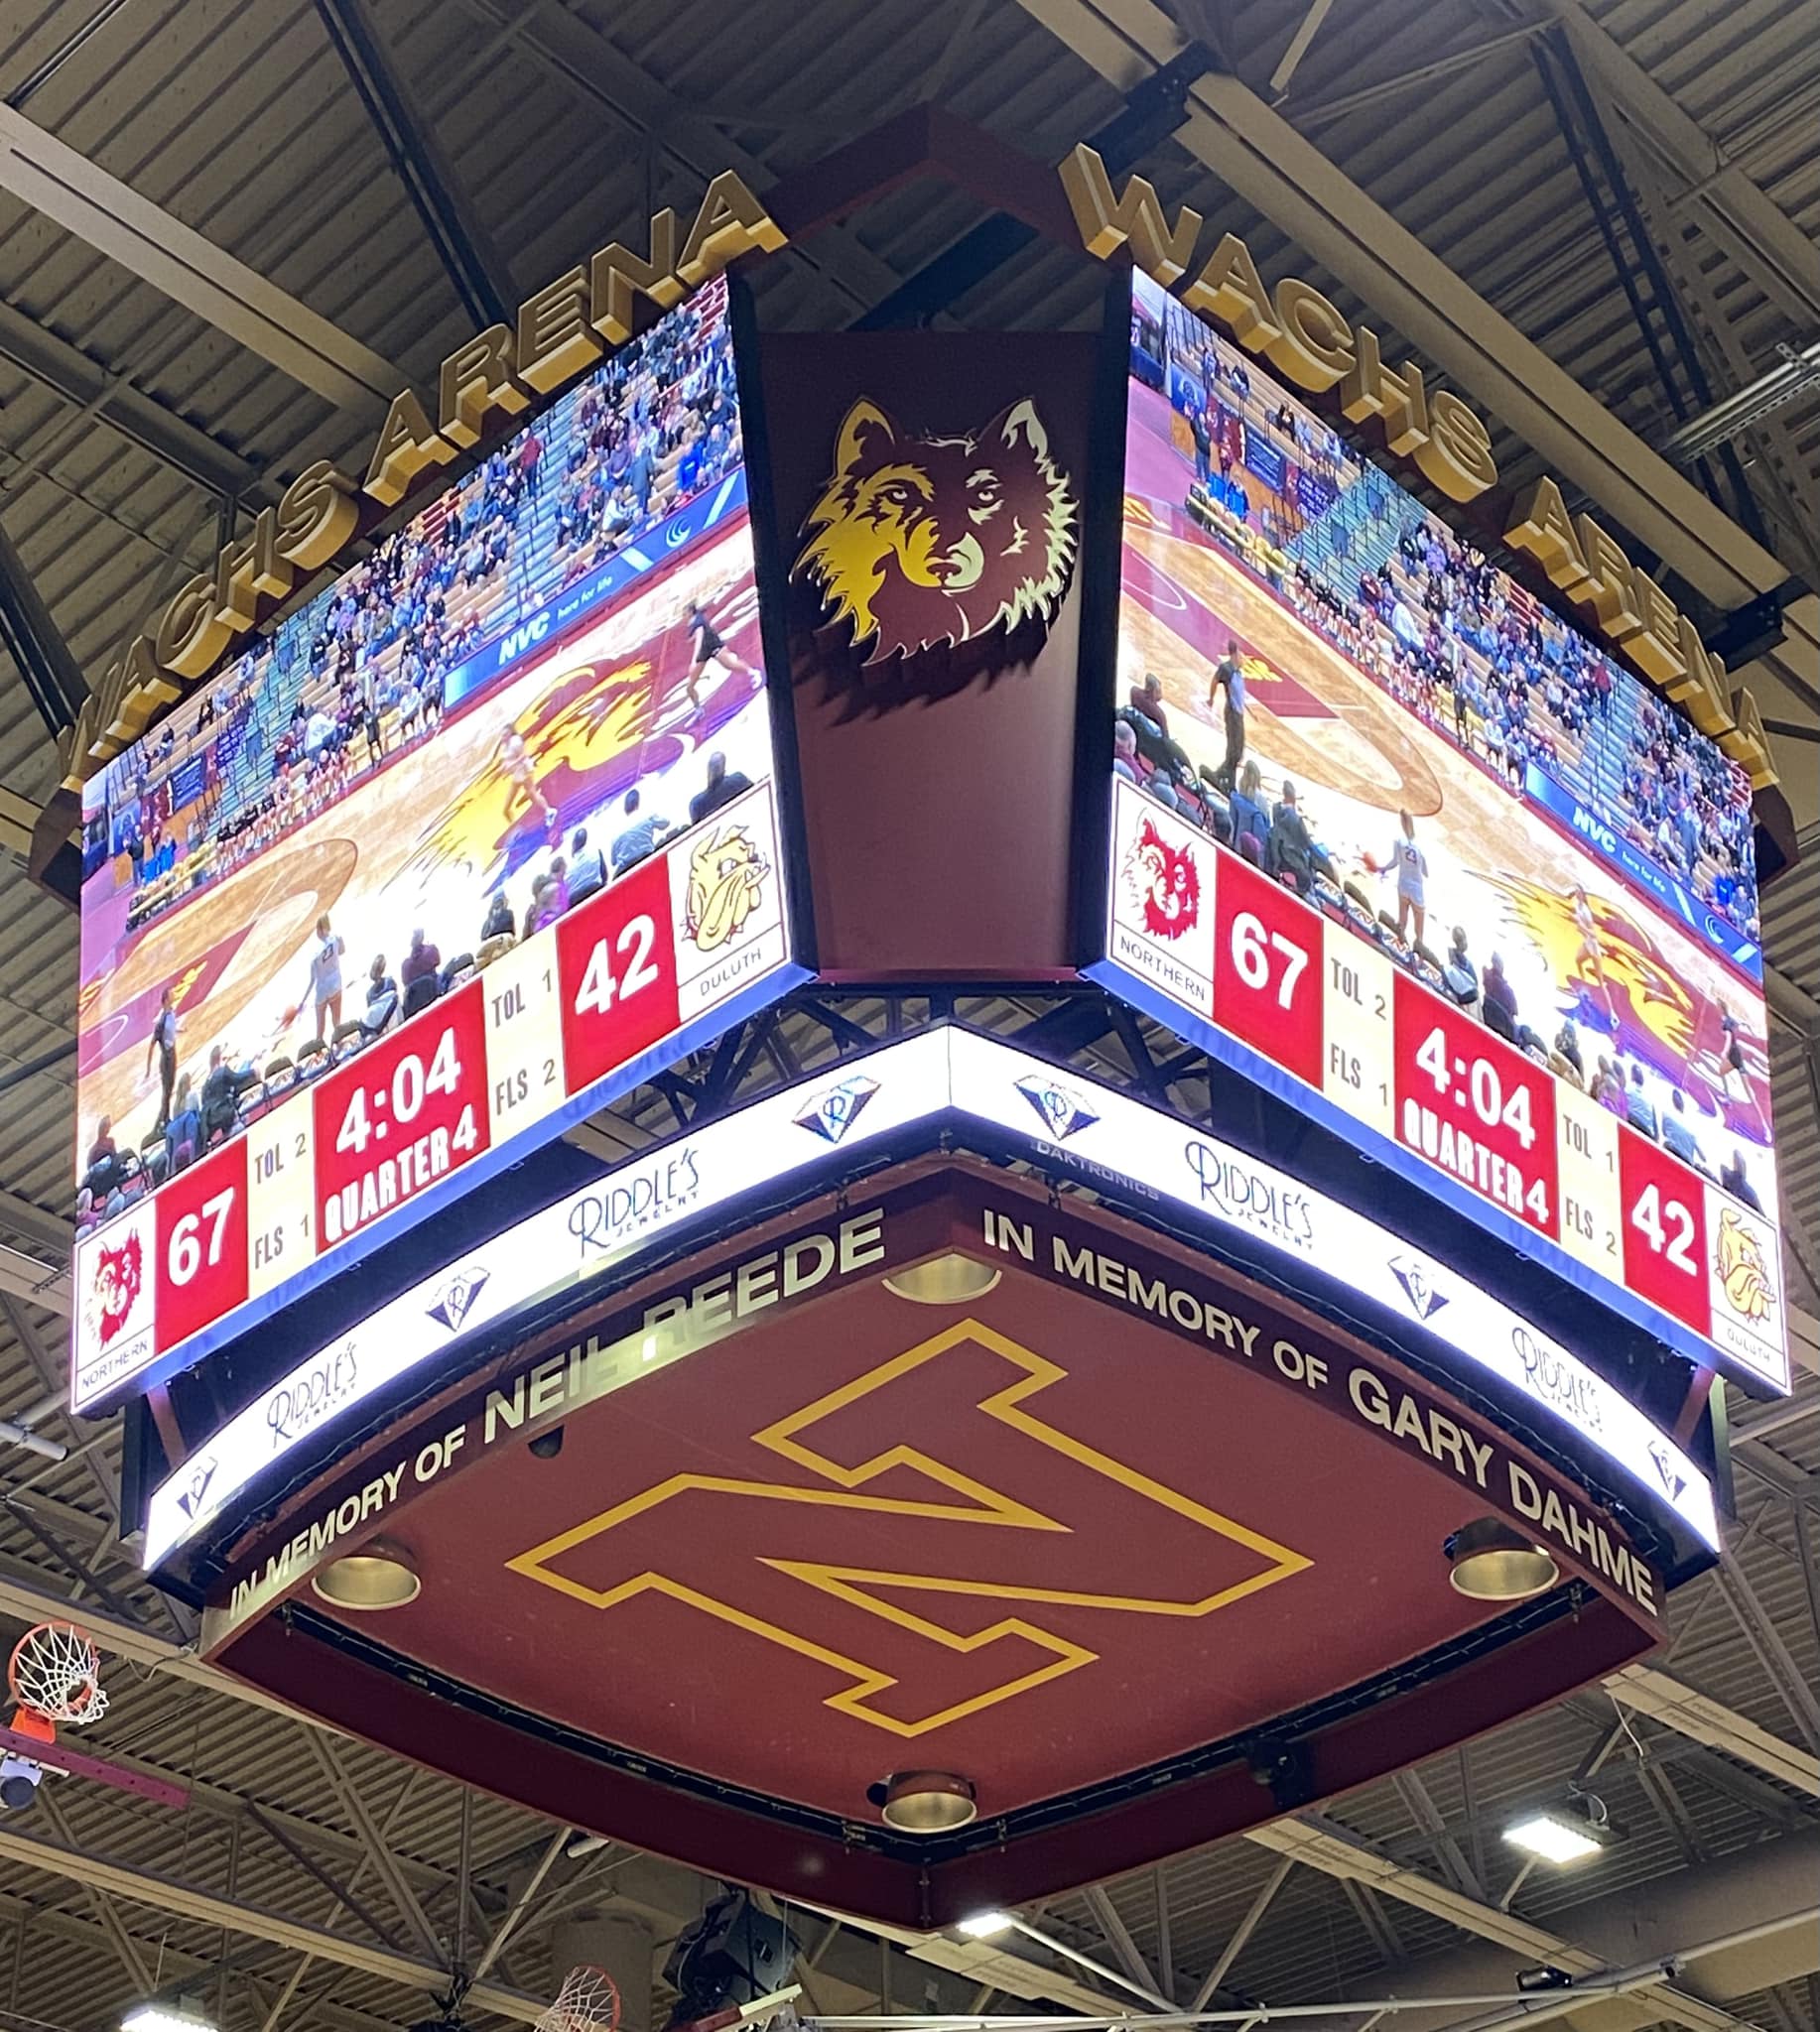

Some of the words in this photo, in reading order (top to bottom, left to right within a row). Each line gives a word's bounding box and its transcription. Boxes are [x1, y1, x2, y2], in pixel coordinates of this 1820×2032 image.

[57, 459, 359, 794] WACHS
[362, 169, 788, 507] ARENA
[1058, 142, 1497, 503] WACHS
[1501, 475, 1779, 791] ARENA
[498, 611, 551, 666] NVC
[1573, 806, 1617, 853] NVC
[491, 982, 526, 1029] TOL
[542, 968, 552, 993] 1
[575, 914, 659, 1016] 42
[700, 947, 762, 996] DULUTH
[1119, 936, 1206, 1002] NORTHERN
[1232, 911, 1308, 1010] 67
[1331, 956, 1363, 1007] TOL
[1374, 994, 1386, 1021] 2
[336, 1027, 461, 1154] 4:04
[495, 1072, 529, 1115] FLS
[544, 1059, 556, 1086] 2
[1331, 1044, 1362, 1090] FLS
[1379, 1082, 1387, 1106] 1
[1416, 1027, 1536, 1150] 4:04
[255, 1143, 285, 1185] TOL
[295, 1133, 307, 1159] 2
[325, 1126, 450, 1243] QUARTER
[453, 1103, 477, 1151] 4
[1036, 1140, 1160, 1202] DAKTRONICS
[1403, 1097, 1524, 1214] QUARTER
[1526, 1178, 1549, 1225] 4
[1563, 1114, 1592, 1160] TOL
[1606, 1150, 1614, 1173] 1
[569, 1148, 700, 1258] RIDDLE'S
[1185, 1141, 1312, 1238] RIDDLE'S
[1565, 1197, 1594, 1240] FLS
[1606, 1230, 1617, 1257] 2
[167, 1186, 235, 1287] 67
[255, 1225, 284, 1270] FLS
[301, 1214, 309, 1237] 1
[1631, 1183, 1698, 1277] 42
[81, 1338, 149, 1389] NORTHERN
[229, 1570, 259, 1620] IN
[265, 1461, 407, 1586] MEMORY
[414, 1425, 466, 1483] OF
[483, 1335, 617, 1446] NEIL
[643, 1207, 886, 1355] REEDE
[983, 1208, 1035, 1262] IN
[1052, 1234, 1261, 1358] MEMORY
[1272, 1339, 1329, 1390] OF
[1349, 1368, 1494, 1488] GARY
[1508, 1460, 1658, 1617] DAHME
